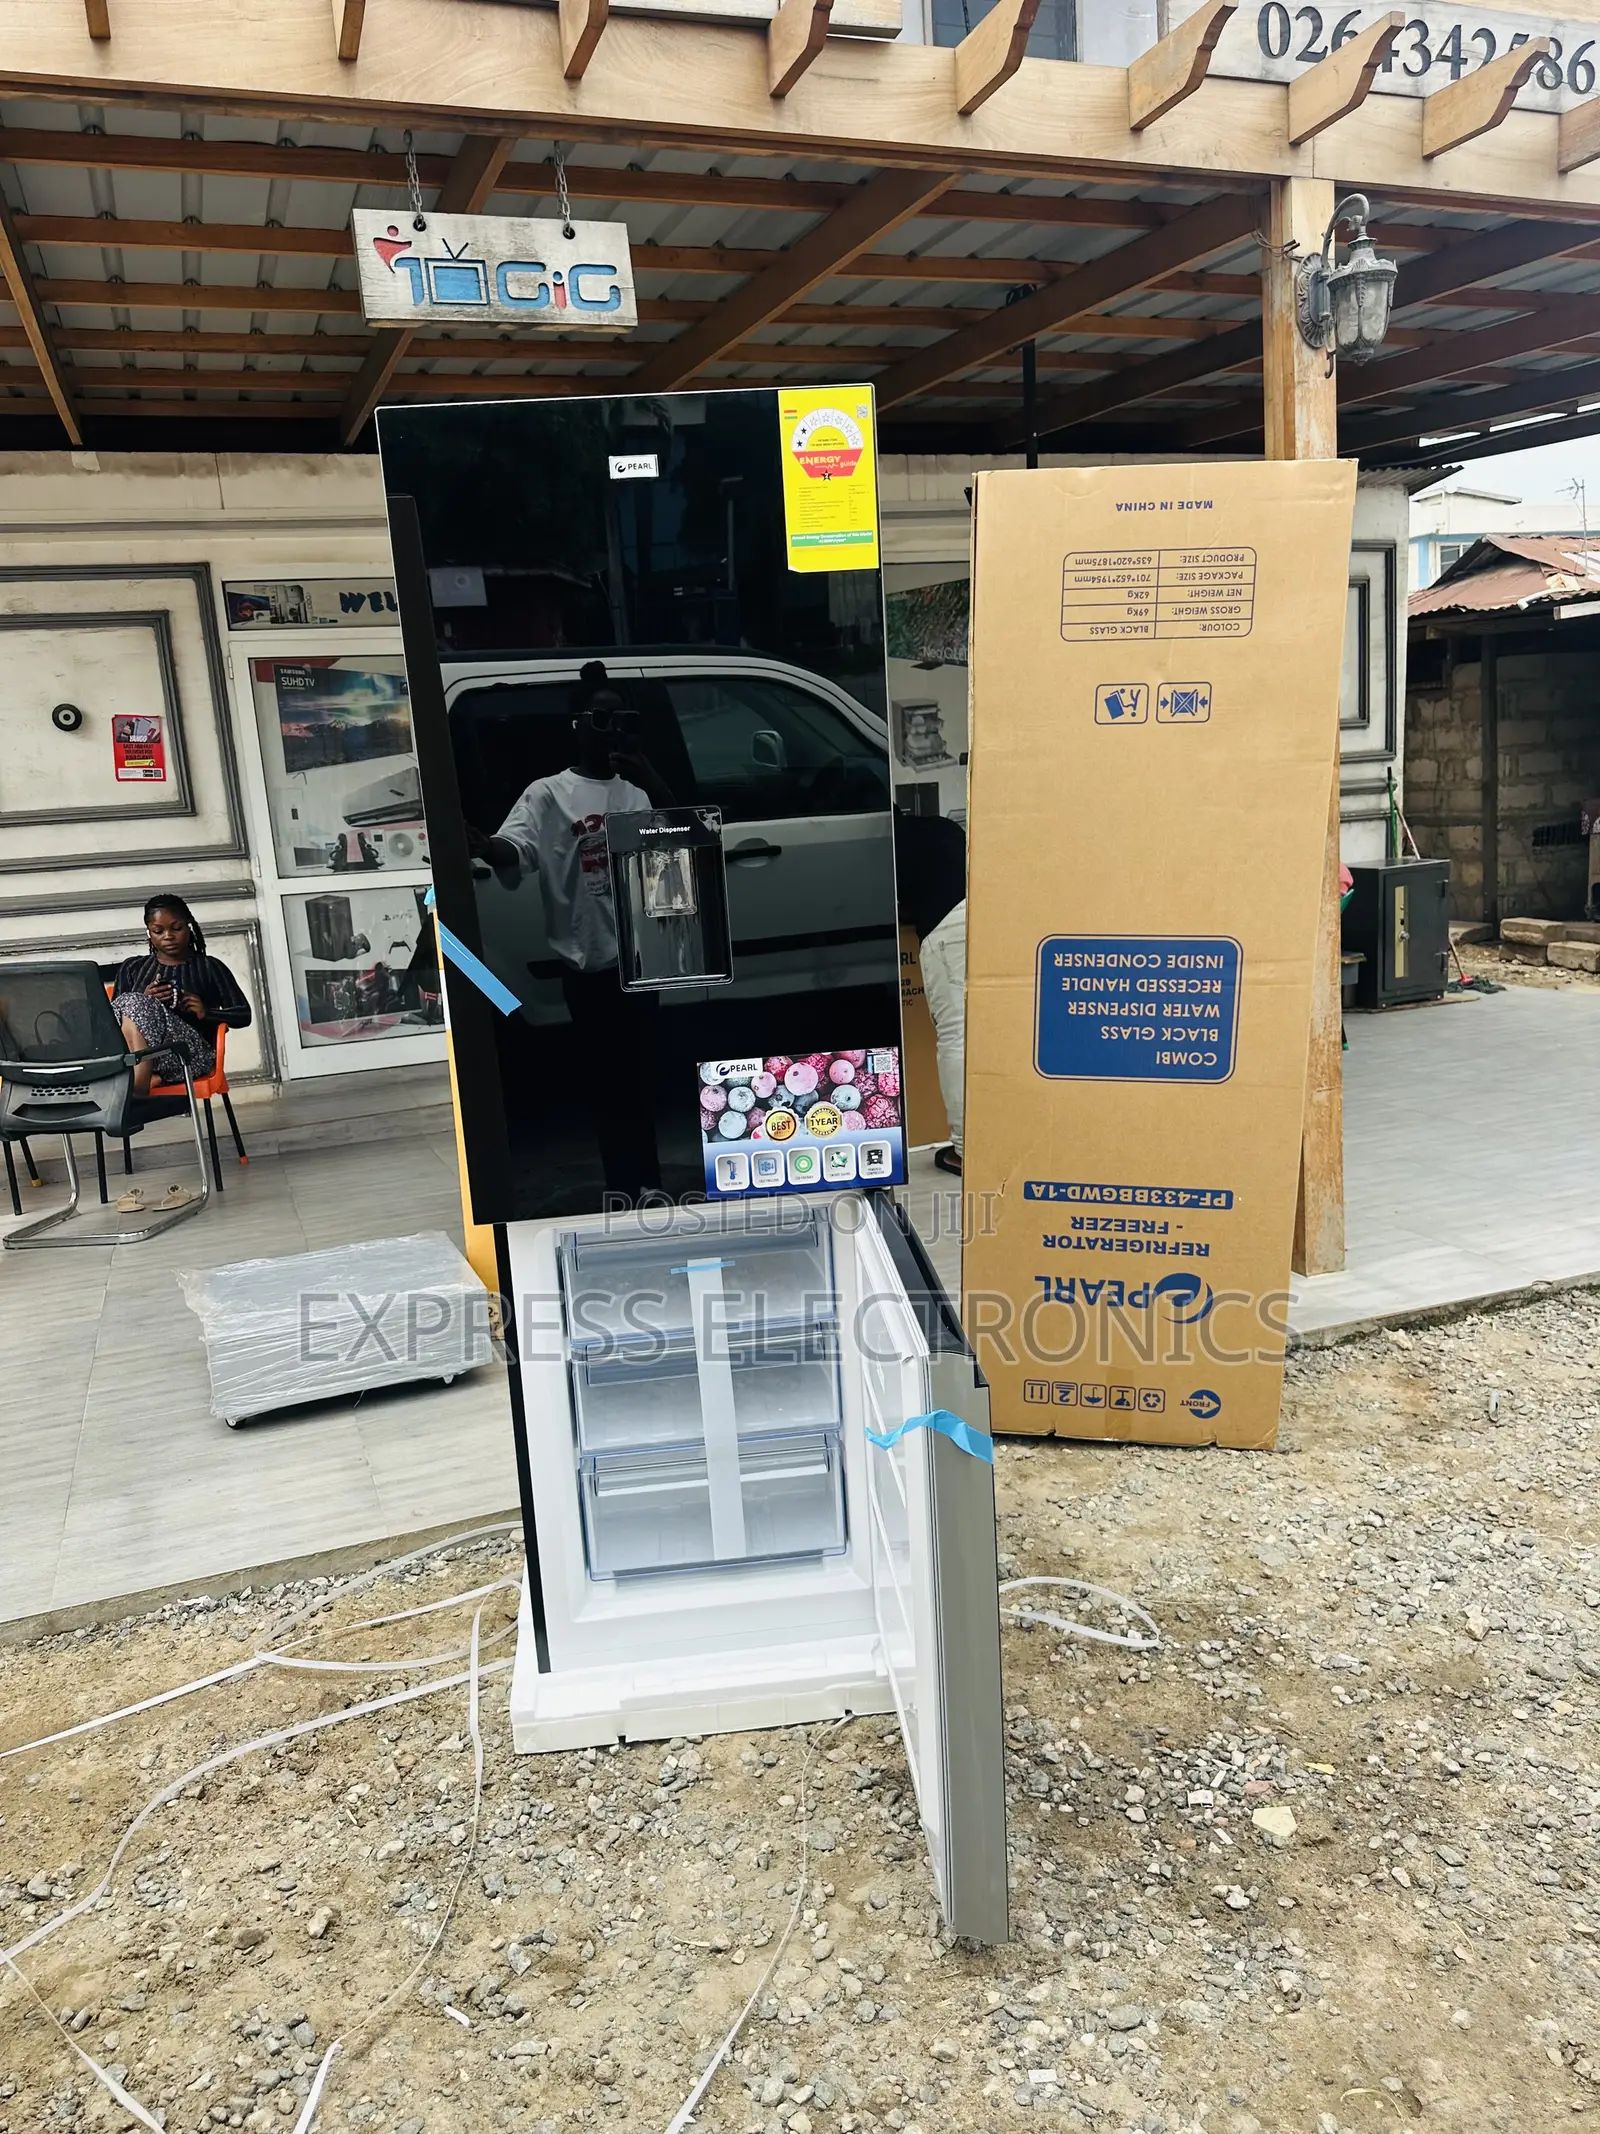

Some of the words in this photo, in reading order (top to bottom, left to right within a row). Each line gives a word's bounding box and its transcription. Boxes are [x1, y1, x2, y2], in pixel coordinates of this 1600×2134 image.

[799, 455, 842, 466] ENERGY
[1115, 502, 1156, 512] CHINA
[1159, 501, 1174, 510] IN
[1177, 500, 1213, 510] MADE
[1179, 555, 1200, 564] SIZE:
[1201, 554, 1245, 564] PRODUCT
[1176, 572, 1196, 581] SIZE:
[1198, 571, 1244, 581] PACKAGE
[1127, 590, 1150, 599] 62Kg
[1187, 589, 1224, 598] WEIGHT:
[1226, 589, 1243, 597] NET
[1126, 607, 1149, 617] 69Kg
[1171, 606, 1208, 615] WEIGHT:
[1210, 606, 1241, 615] GROSS
[1089, 625, 1118, 635] GLASS
[1119, 624, 1149, 633] BLACK
[1199, 622, 1240, 631] COLOUR:
[659, 826, 691, 834] Dispenser
[1054, 953, 1161, 968] CONDENSER
[1167, 954, 1224, 969] INSIDE
[1062, 977, 1130, 992] HANDLE
[1136, 979, 1222, 993] RECESSED
[1068, 1001, 1156, 1017] DISPENSER
[1162, 1003, 1220, 1018] WATER
[1100, 1025, 1156, 1040] GLASS
[1161, 1027, 1219, 1042] BLACK
[1155, 1051, 1217, 1066] COMBI
[730, 1063, 758, 1073] PEARL
[771, 1120, 792, 1131] BEST
[815, 1117, 838, 1126] YEAR
[1031, 1183, 1227, 1207] PF-433BBGWD-1A
[1070, 1216, 1169, 1235] FREEZER
[1042, 1234, 1210, 1257] REFRIGERATOR
[1034, 1275, 1151, 1309] PEARL
[1180, 1400, 1211, 1408] FRONT
